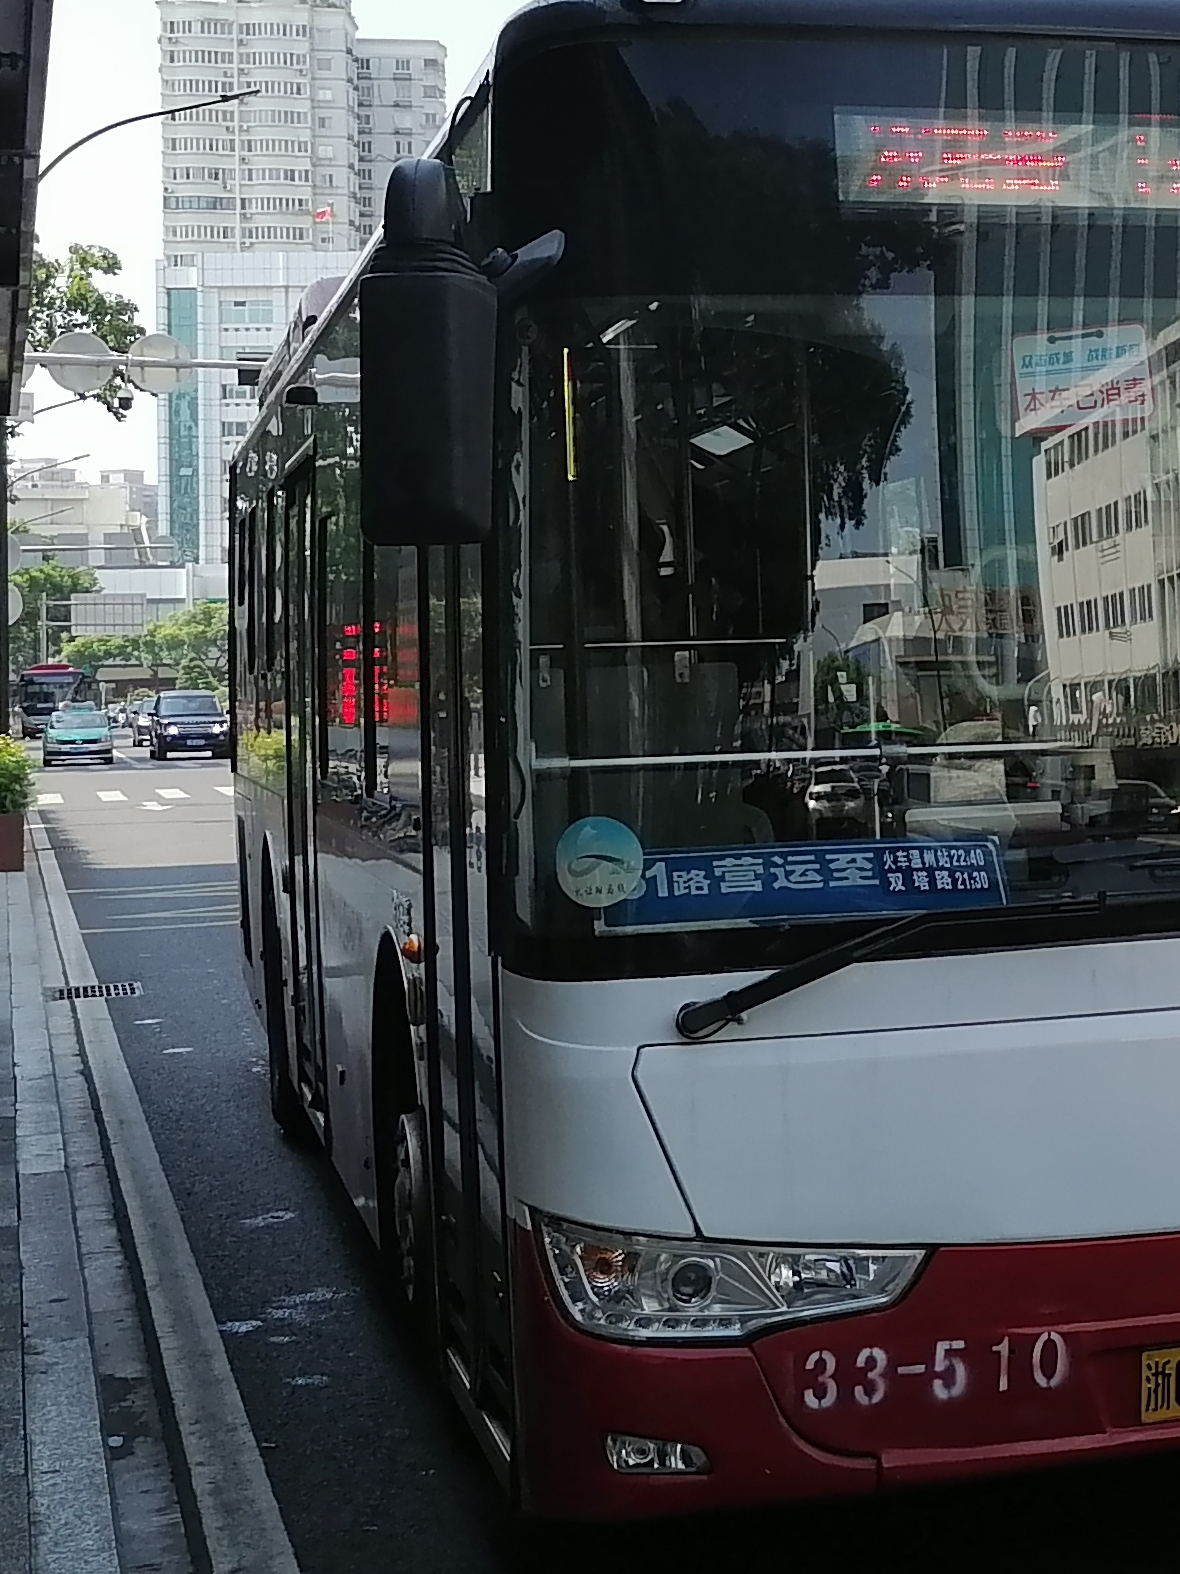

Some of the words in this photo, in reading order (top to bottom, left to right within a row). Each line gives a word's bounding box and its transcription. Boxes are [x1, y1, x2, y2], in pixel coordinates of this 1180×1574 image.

[1021, 350, 1074, 369] 众志成城
[1023, 377, 1147, 413] 本车已消毒
